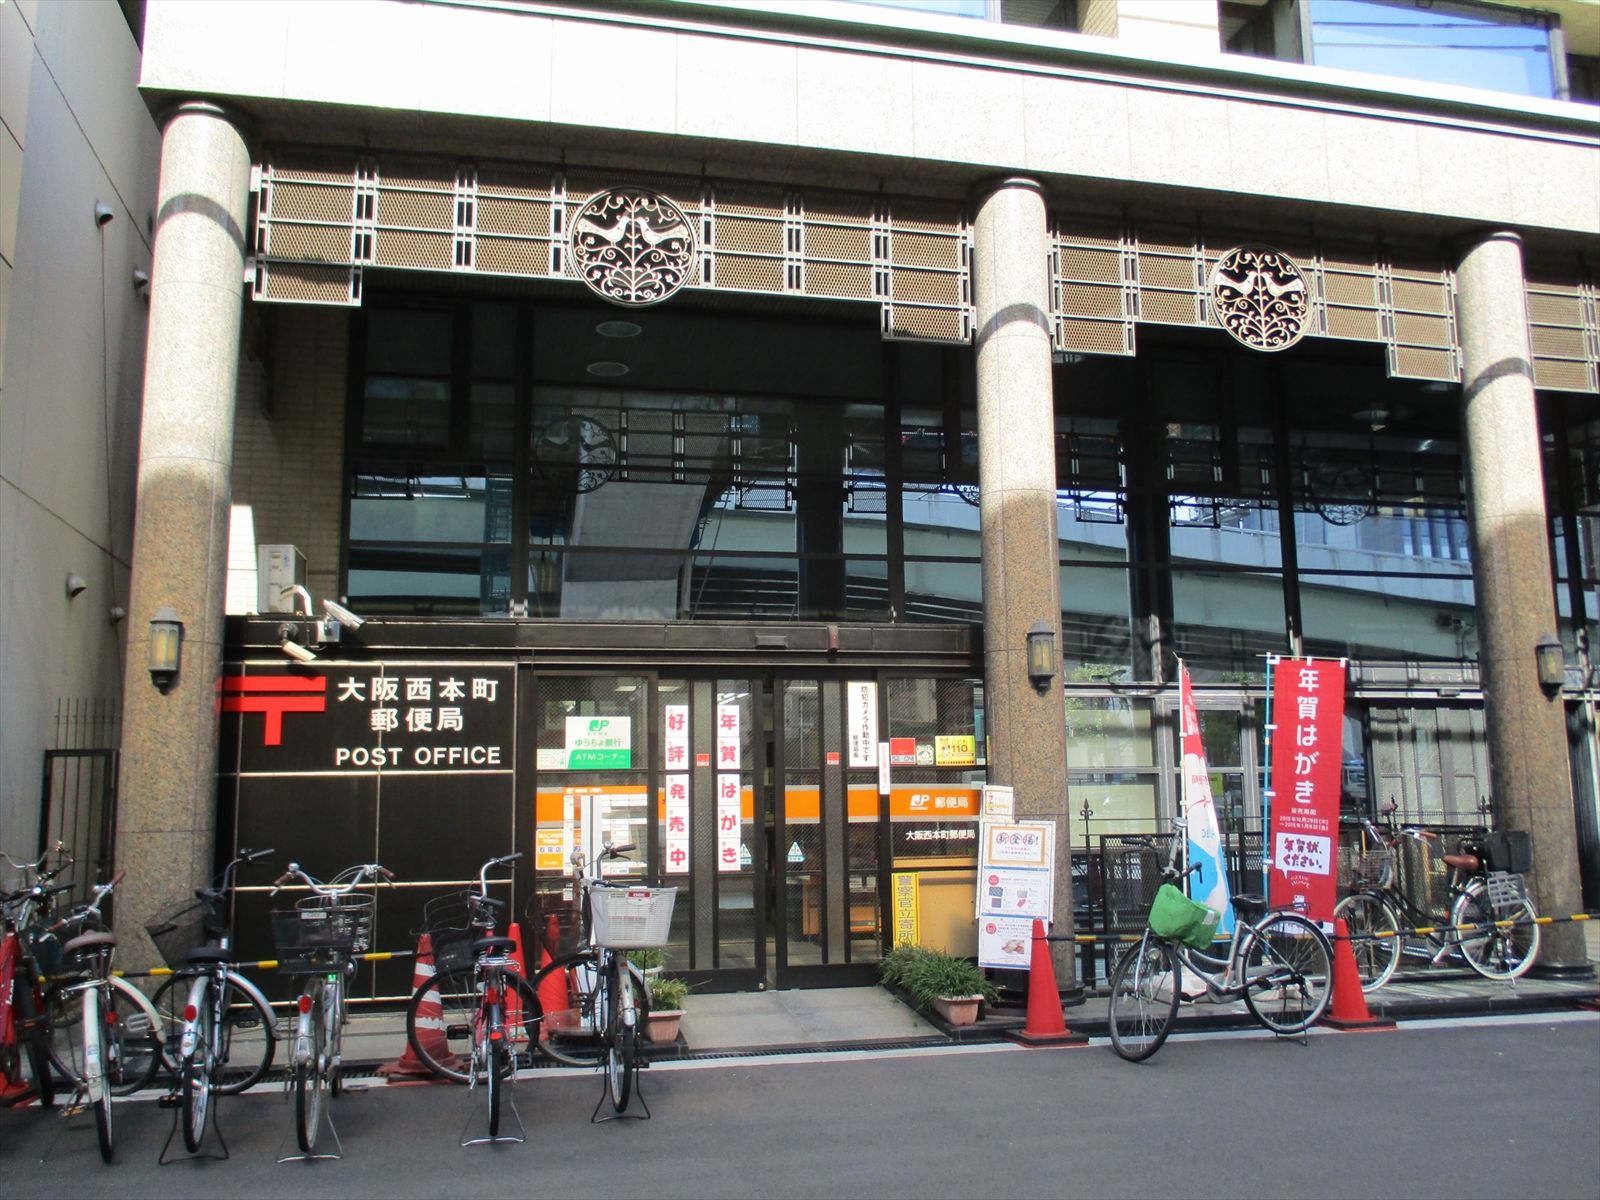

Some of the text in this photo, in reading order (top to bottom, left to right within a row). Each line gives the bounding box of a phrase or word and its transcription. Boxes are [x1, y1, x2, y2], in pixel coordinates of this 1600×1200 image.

[337, 676, 499, 702] 大阪西本町
[370, 707, 464, 732] 郵便局
[1294, 668, 1320, 804] 年賀はがき
[335, 746, 501, 766] POST OFFICE
[668, 713, 686, 866] 好評発売中
[719, 713, 738, 864] 年賀はがき
[934, 796, 969, 809] 郵便局
[905, 829, 976, 841] 大阪西本町郵便局
[1283, 837, 1323, 855] 年賀状、
[1283, 853, 1323, 870] ください。
